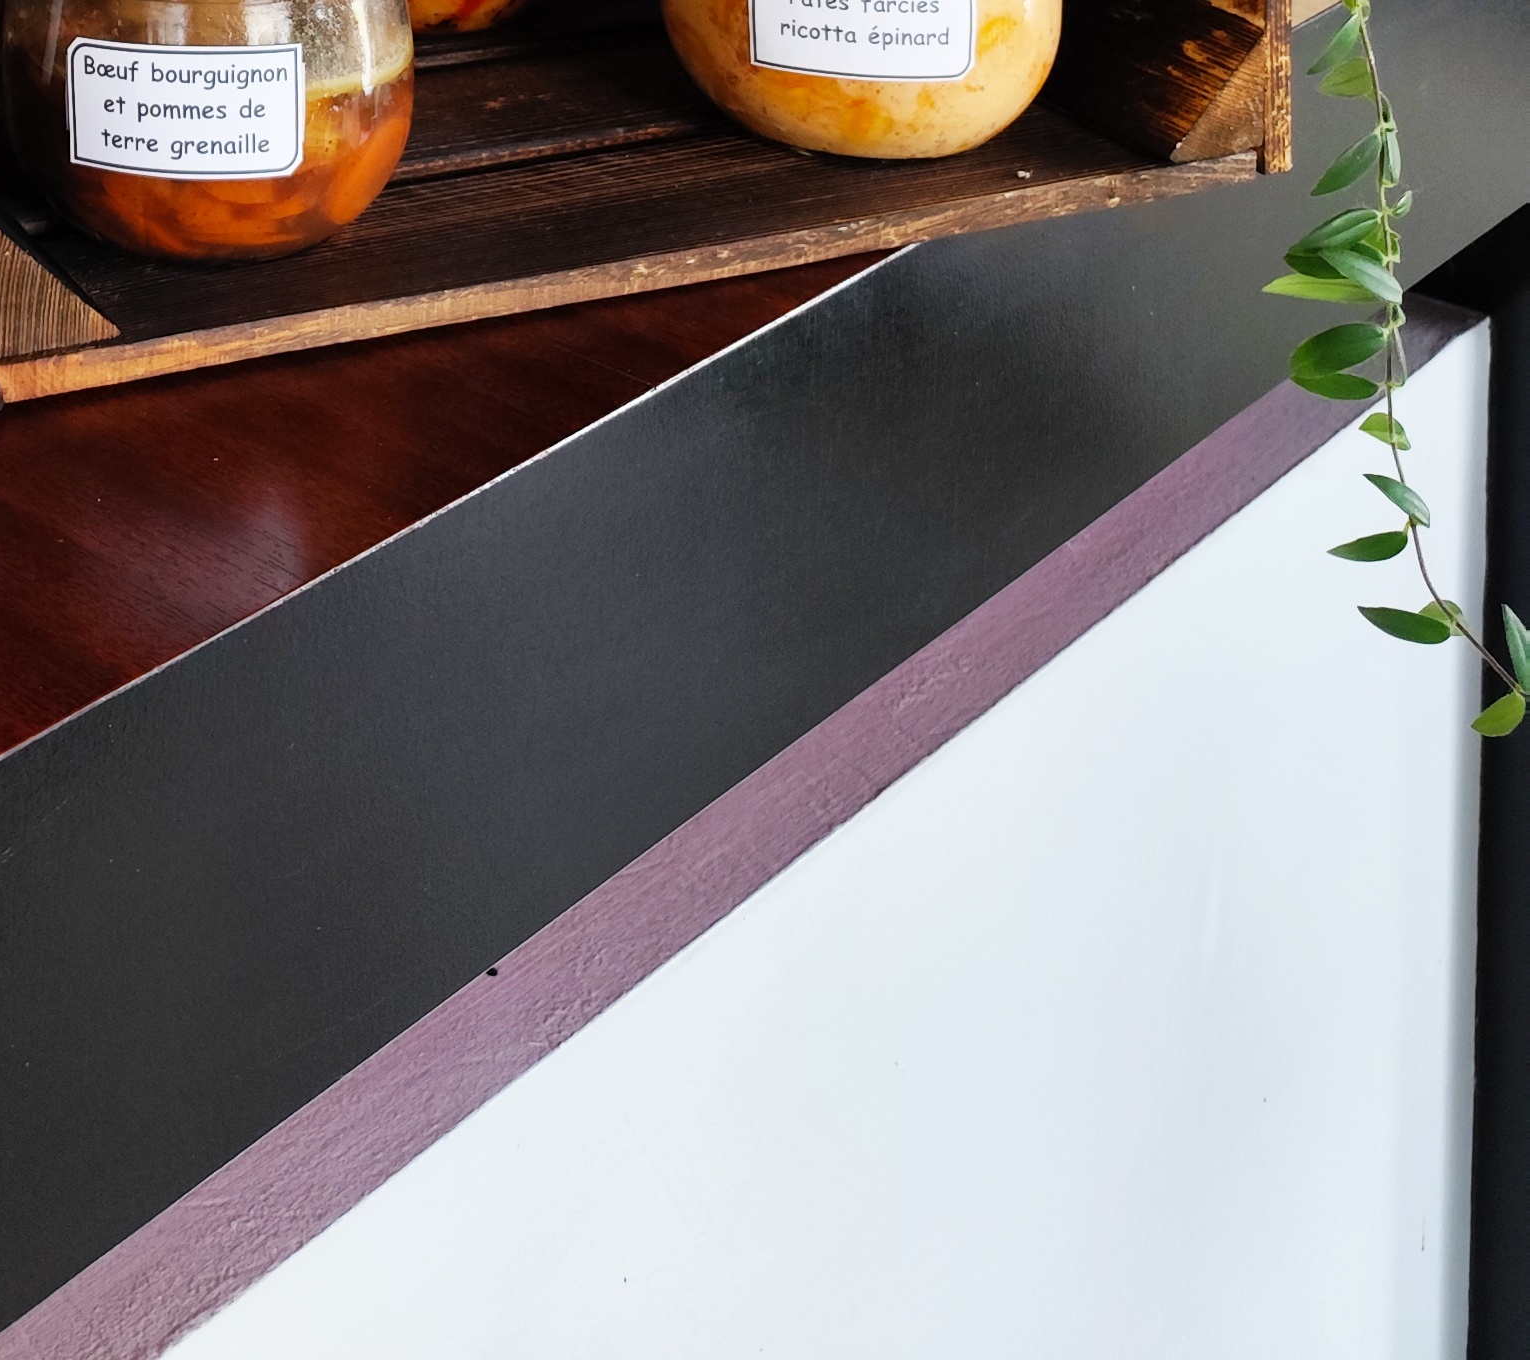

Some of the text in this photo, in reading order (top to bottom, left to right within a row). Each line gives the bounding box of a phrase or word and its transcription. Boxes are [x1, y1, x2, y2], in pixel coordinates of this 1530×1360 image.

[780, 19, 950, 51] ricotta épinard
[83, 54, 288, 91] Bœuf bourguignon
[103, 96, 266, 123] et pommes de
[100, 128, 270, 161] terre grenaille
